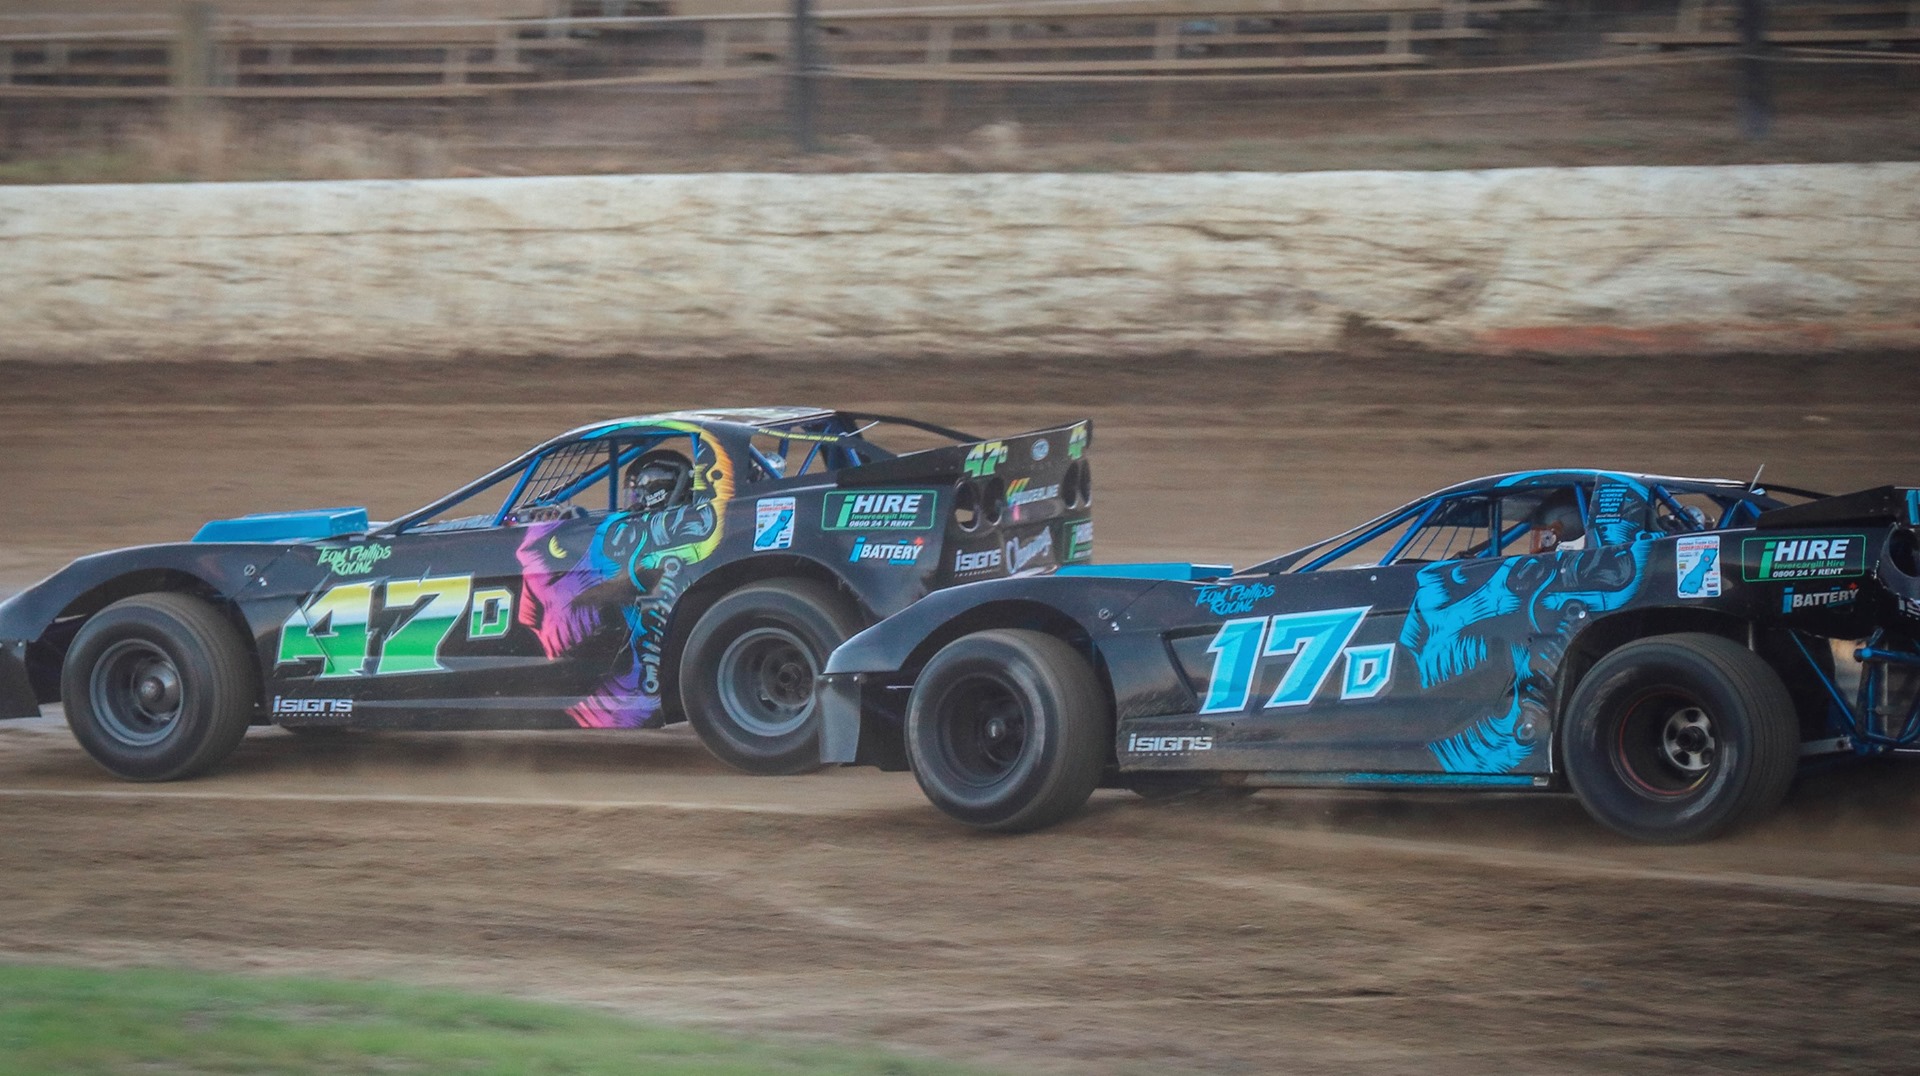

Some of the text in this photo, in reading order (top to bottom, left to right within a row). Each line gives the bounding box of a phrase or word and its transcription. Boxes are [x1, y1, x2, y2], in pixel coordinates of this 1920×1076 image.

[963, 441, 1009, 478] 47D
[836, 494, 923, 527] iHIRE
[849, 536, 924, 563] iBATTERY
[1758, 539, 1850, 578] iHIRE
[1774, 561, 1824, 570] Invercargill
[1772, 570, 1795, 578] 0800
[1796, 569, 1809, 577] 24
[1817, 568, 1844, 576] RENT
[1782, 587, 1859, 613] iBATTERY
[275, 574, 514, 680] 47D
[1199, 605, 1397, 715] 17D
